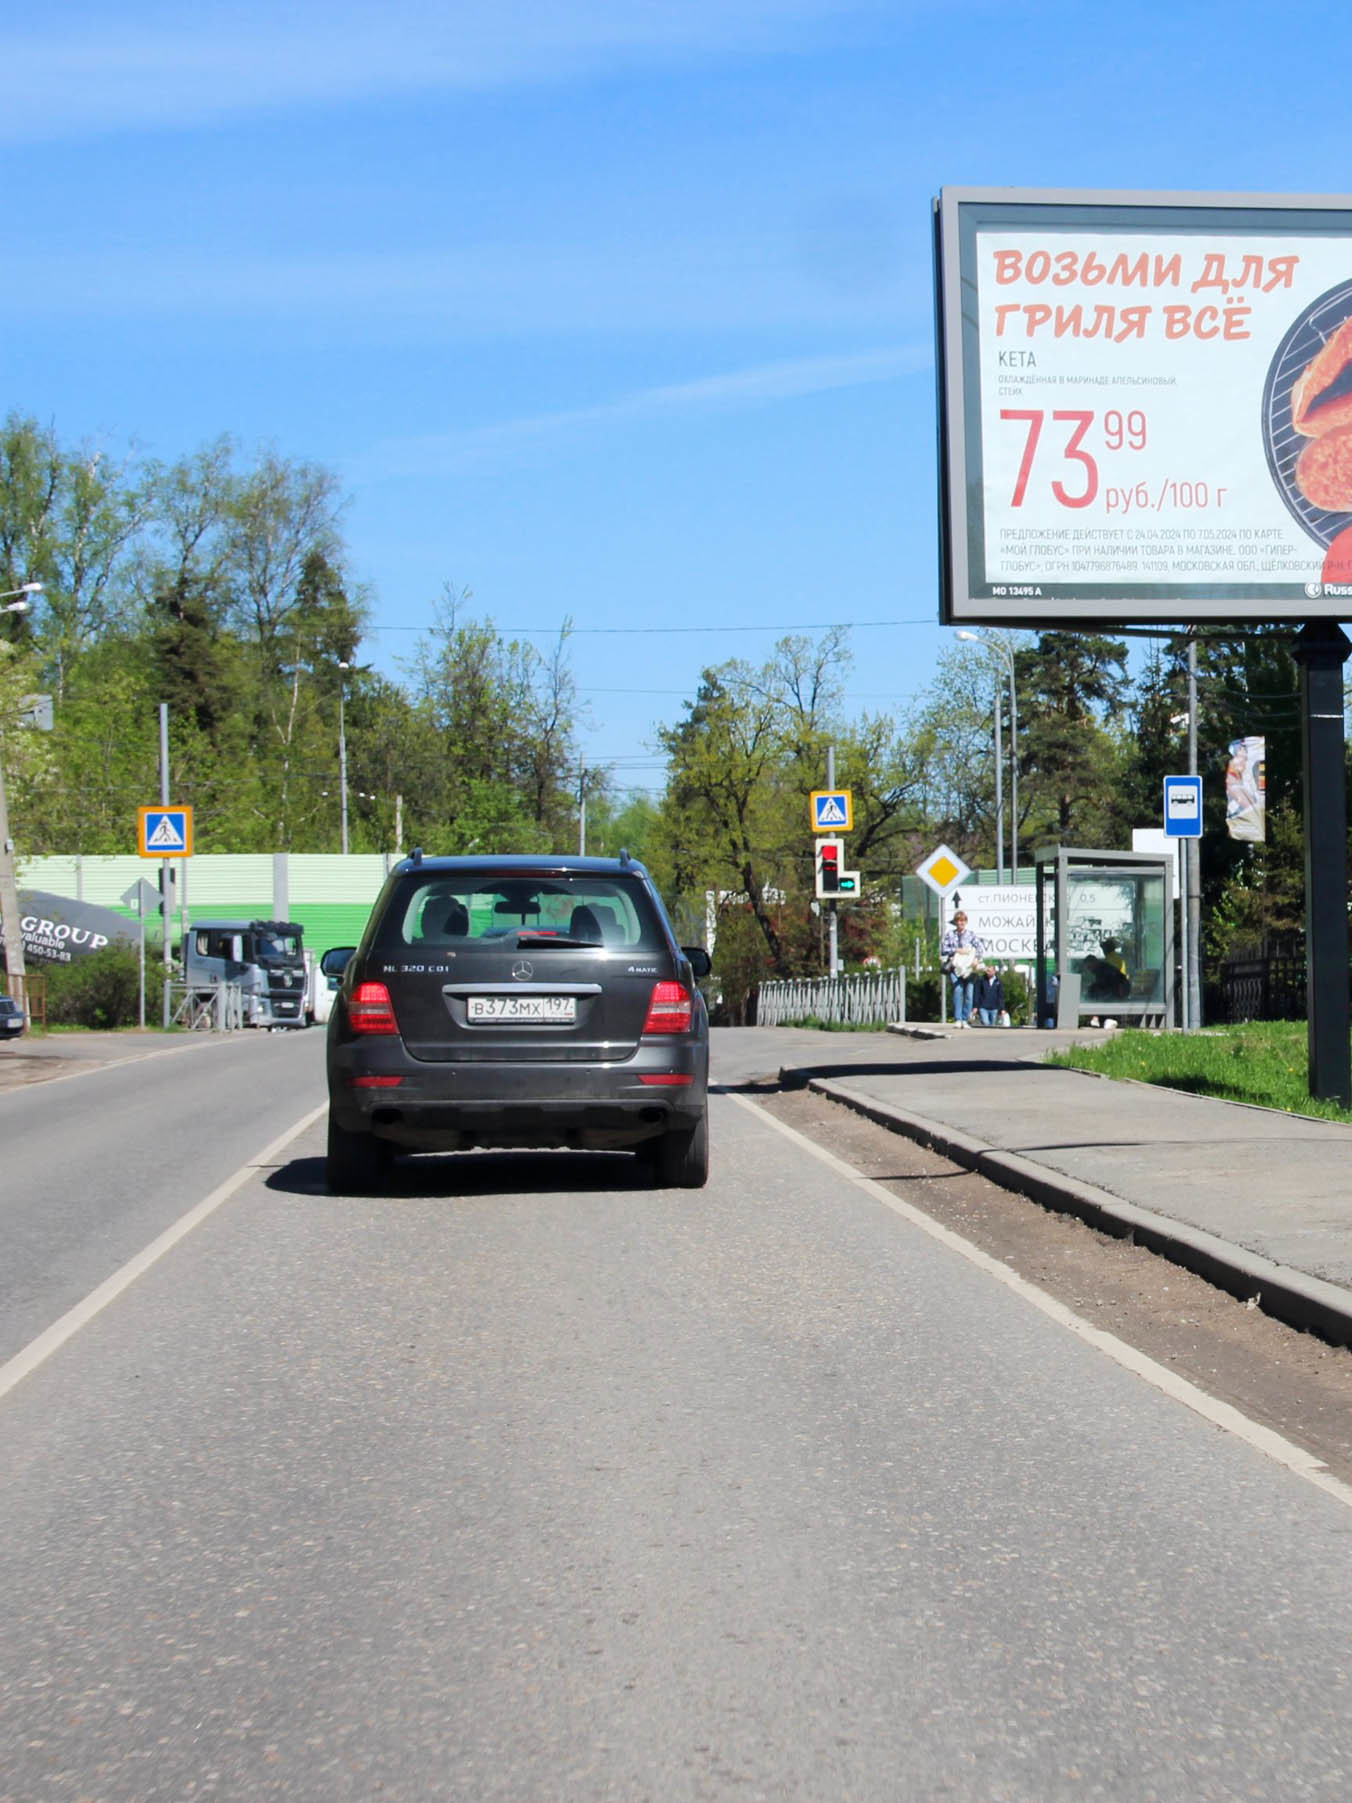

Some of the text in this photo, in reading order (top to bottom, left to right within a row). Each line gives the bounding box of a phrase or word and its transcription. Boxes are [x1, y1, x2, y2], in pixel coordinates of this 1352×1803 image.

[993, 250, 1300, 295] ВОЗЬМИ ДЛЯ
[994, 296, 1252, 344] ГРИЛЯ ВСЁ
[998, 351, 1037, 368] КЕТА
[1066, 376, 1109, 387] МАРИНАДЕ
[999, 409, 1147, 509] 73 99
[1106, 478, 1229, 514] руб./100 г
[1000, 528, 1070, 540] ПРЕДЛОЖЕНИЕ
[1072, 527, 1124, 541] ДЕЙСТВУЕТ
[1127, 529, 1133, 540] С
[1183, 529, 1197, 540] ПО
[1239, 529, 1252, 540] ПО
[1254, 529, 1283, 540] КАРТЕ
[1072, 545, 1091, 556] ПРИ
[1094, 545, 1138, 556] НАЛИЧИИ
[1141, 545, 1175, 556] ТОВАРА
[1177, 545, 1184, 556] В
[1238, 545, 1257, 556] ООО
[1045, 561, 1069, 572] ОГРН
[1172, 561, 1234, 572] МОСКОВСКАЯ
[978, 914, 1056, 928] МОЖАЙК
[21, 916, 108, 949] GROUP
[981, 938, 1055, 953] МОСКА
